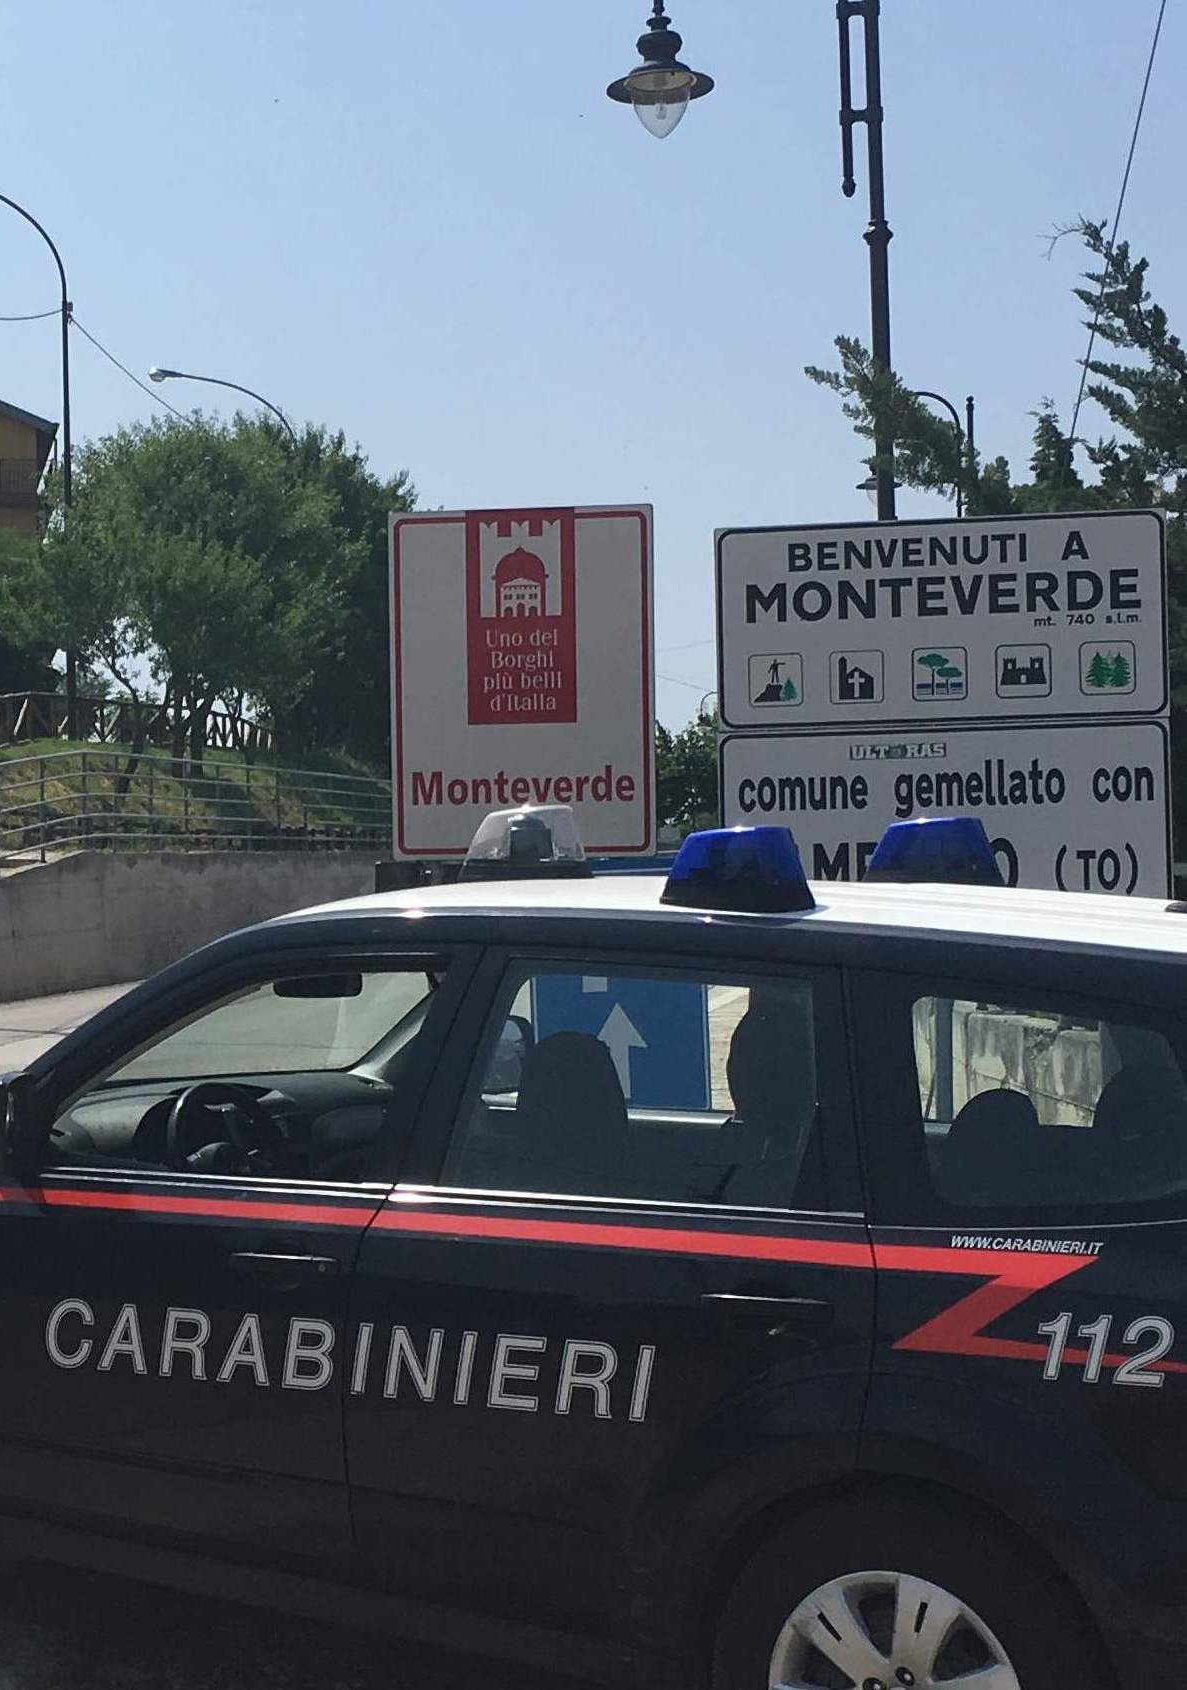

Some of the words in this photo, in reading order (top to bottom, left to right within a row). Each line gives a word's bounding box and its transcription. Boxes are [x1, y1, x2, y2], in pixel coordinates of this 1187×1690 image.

[787, 533, 1028, 573] BENVENUTI
[1061, 530, 1090, 561] A
[744, 568, 1143, 625] MONTEVERDE
[486, 629, 524, 648] Uno
[529, 628, 559, 647] dei
[1033, 616, 1057, 628] mt.
[1066, 613, 1095, 626] 740
[482, 672, 513, 694] più
[520, 671, 562, 690] belli
[490, 650, 555, 672] Borghi
[489, 693, 557, 712] d'Italia
[411, 764, 636, 807] Monteverde
[738, 773, 869, 813] comune
[894, 758, 1066, 818] gemellato
[1092, 765, 1156, 803] con
[1055, 842, 1140, 897] (TO)
[950, 1234, 1105, 1256] WWW.CARABINIERI.IT
[44, 1297, 657, 1422] CARABINIERI
[1037, 1311, 1176, 1388] 112
